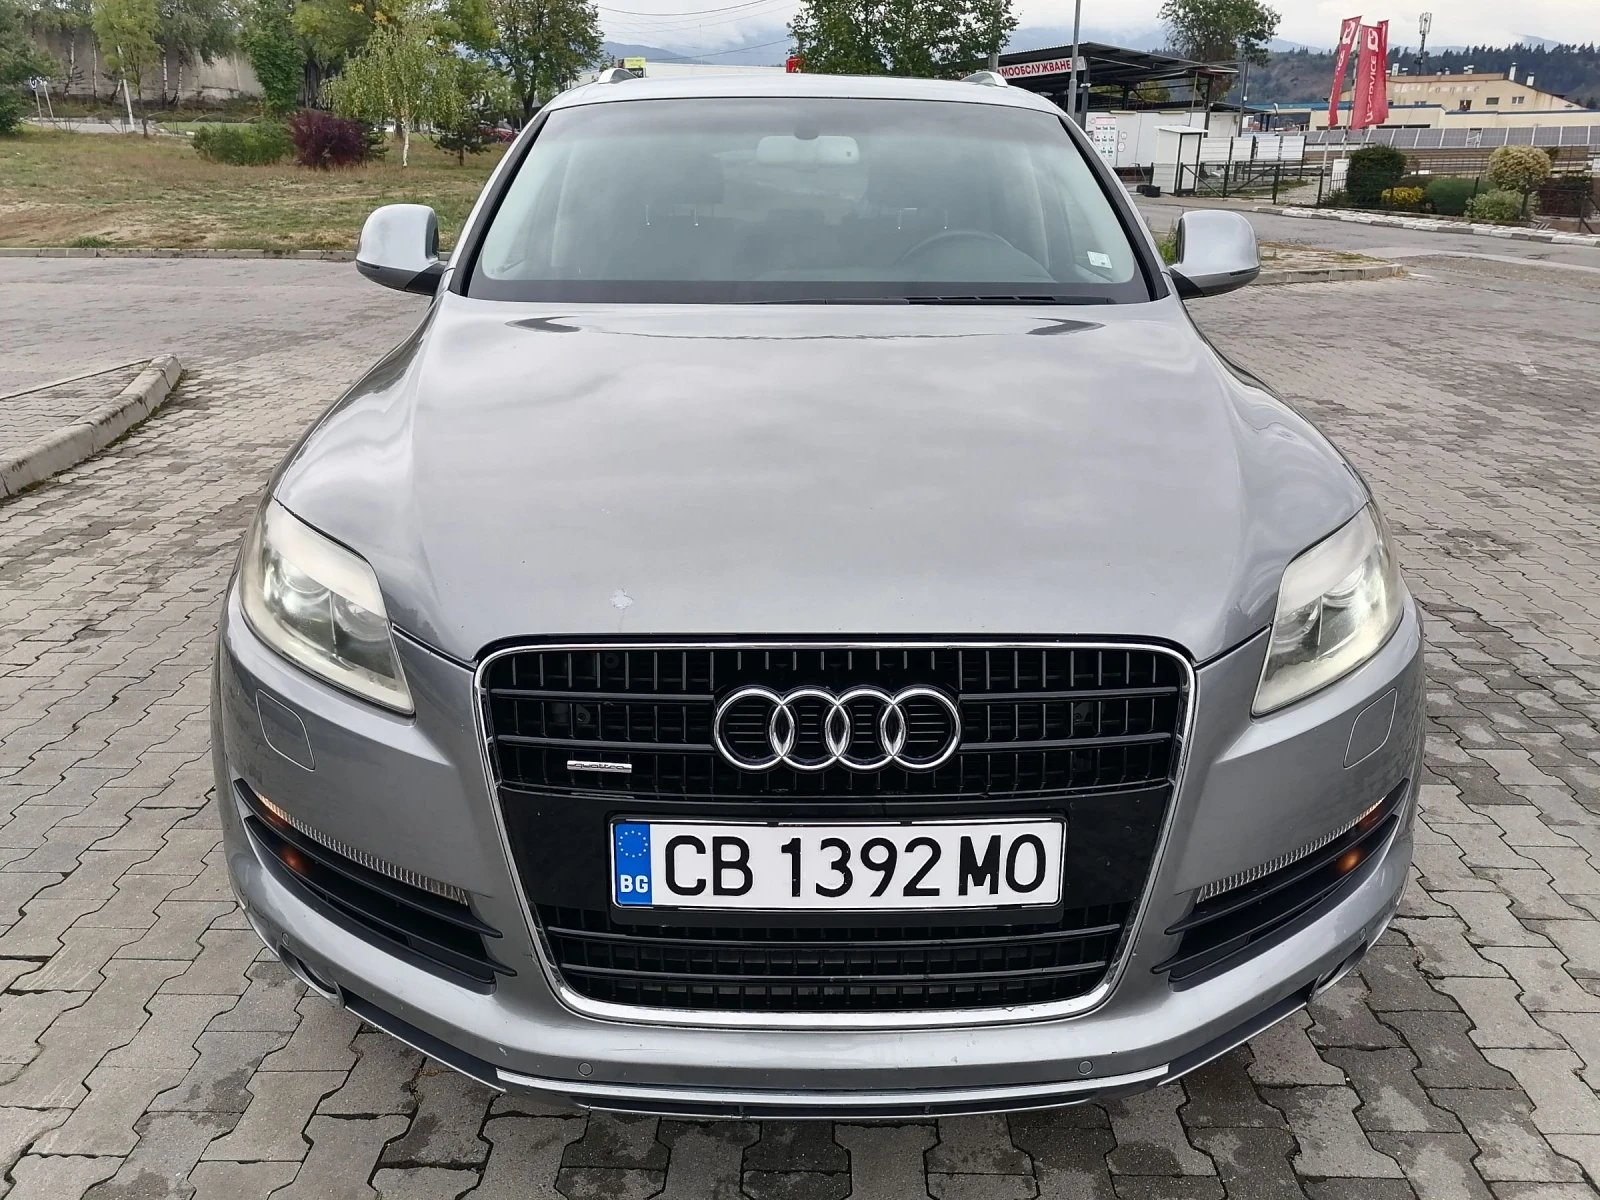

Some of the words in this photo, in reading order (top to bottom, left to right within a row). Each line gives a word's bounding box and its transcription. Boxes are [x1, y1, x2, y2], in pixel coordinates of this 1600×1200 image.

[620, 874, 649, 893] BG
[665, 835, 753, 896] CB
[780, 836, 942, 897] 1392
[958, 833, 1047, 896] MO
